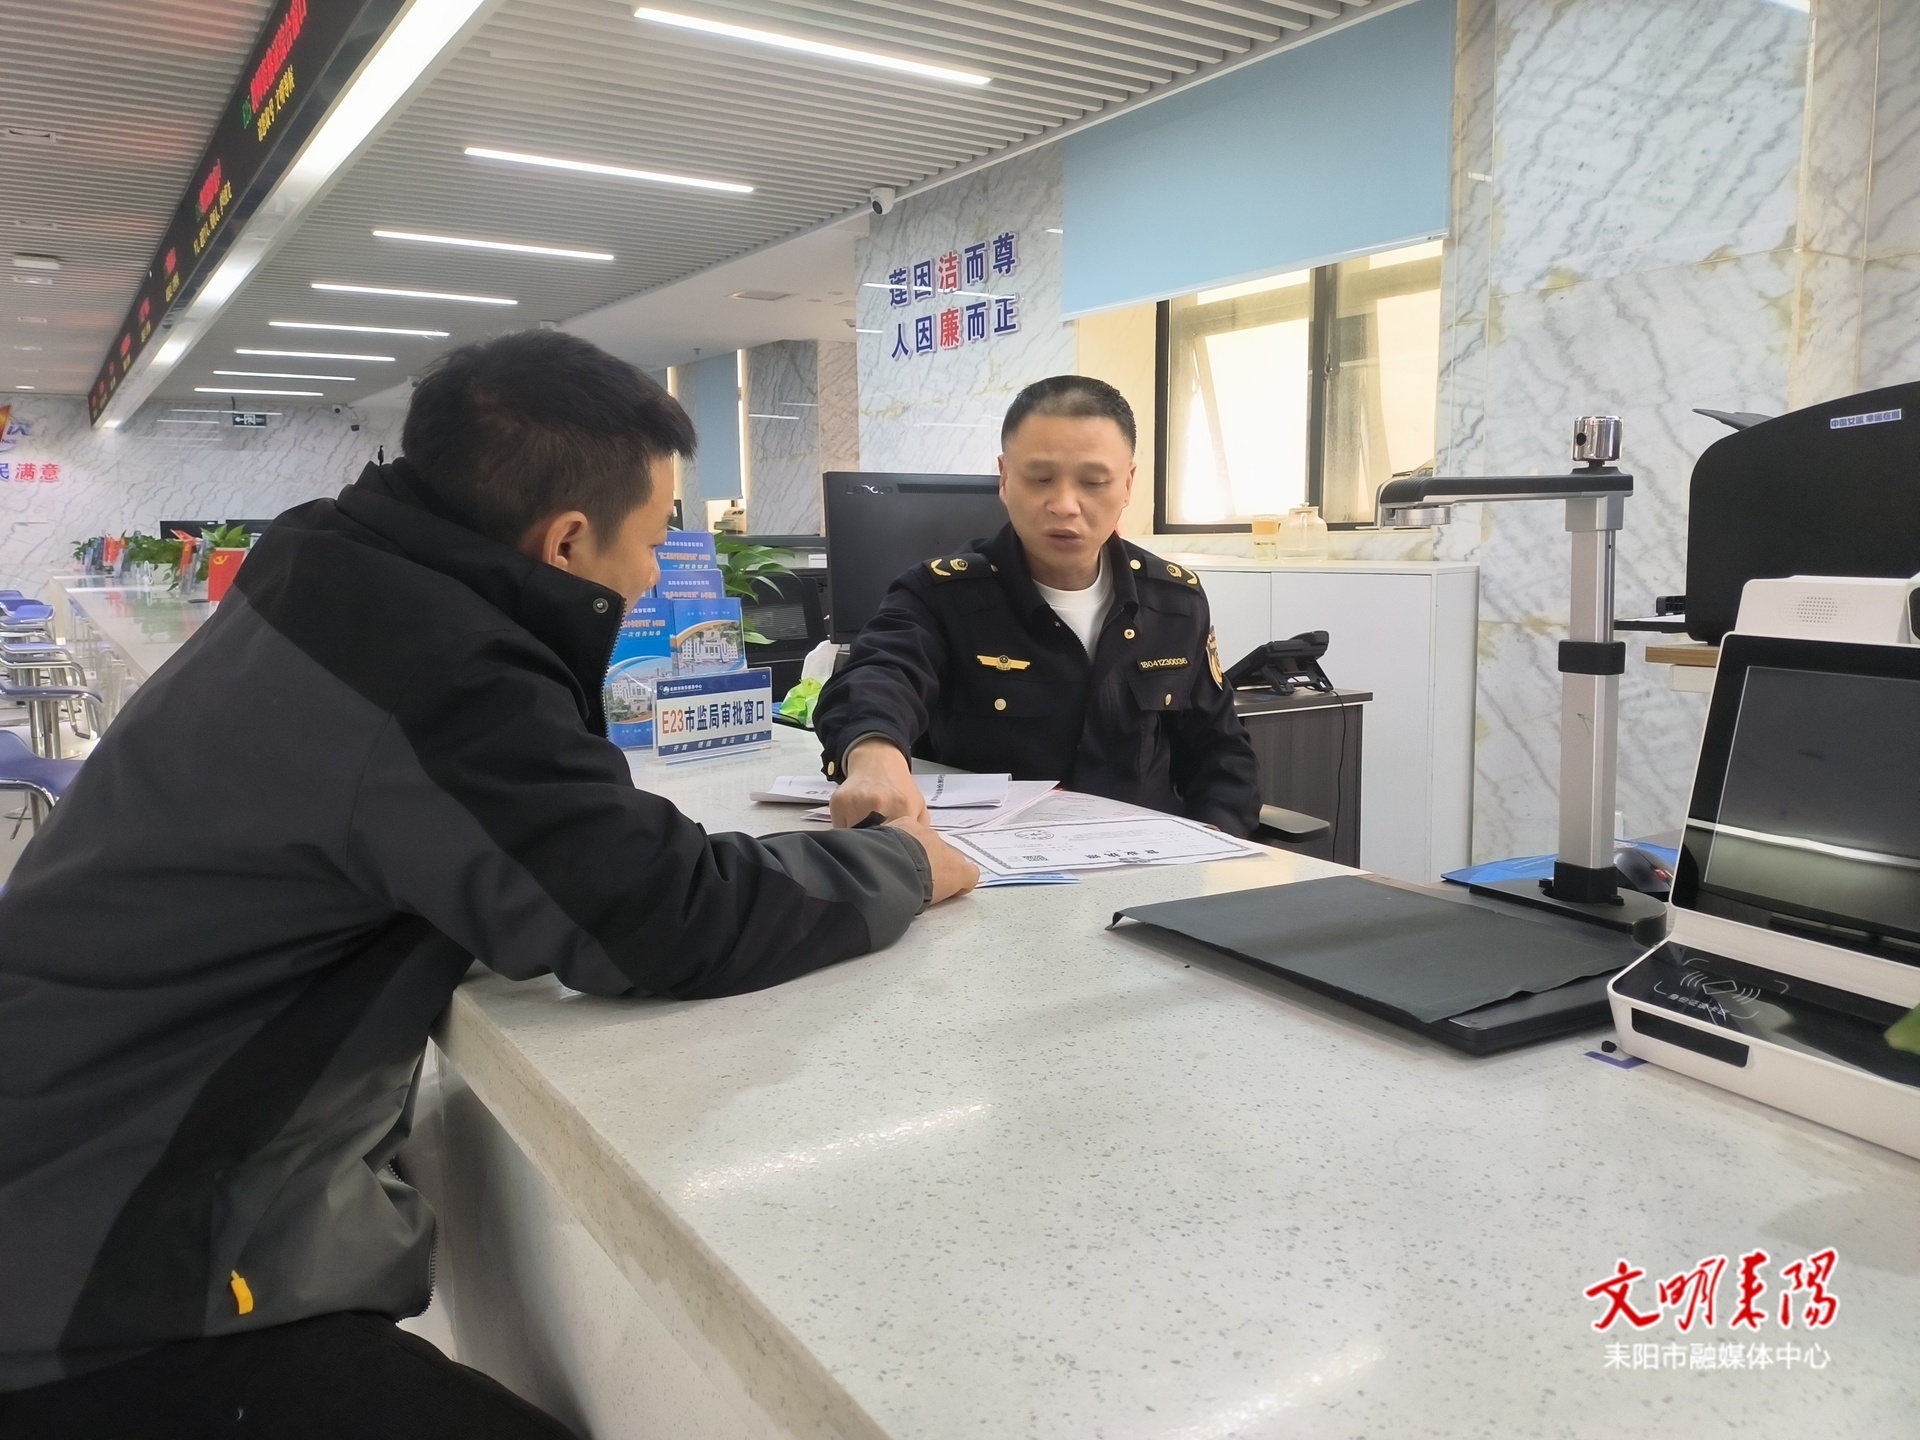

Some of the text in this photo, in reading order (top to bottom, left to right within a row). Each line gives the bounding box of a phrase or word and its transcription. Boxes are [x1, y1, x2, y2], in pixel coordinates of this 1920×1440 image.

[889, 232, 1016, 307] 莲因洁而尊
[891, 298, 1017, 359] 人因廉而正
[662, 699, 765, 735] E23市监局审批窗口
